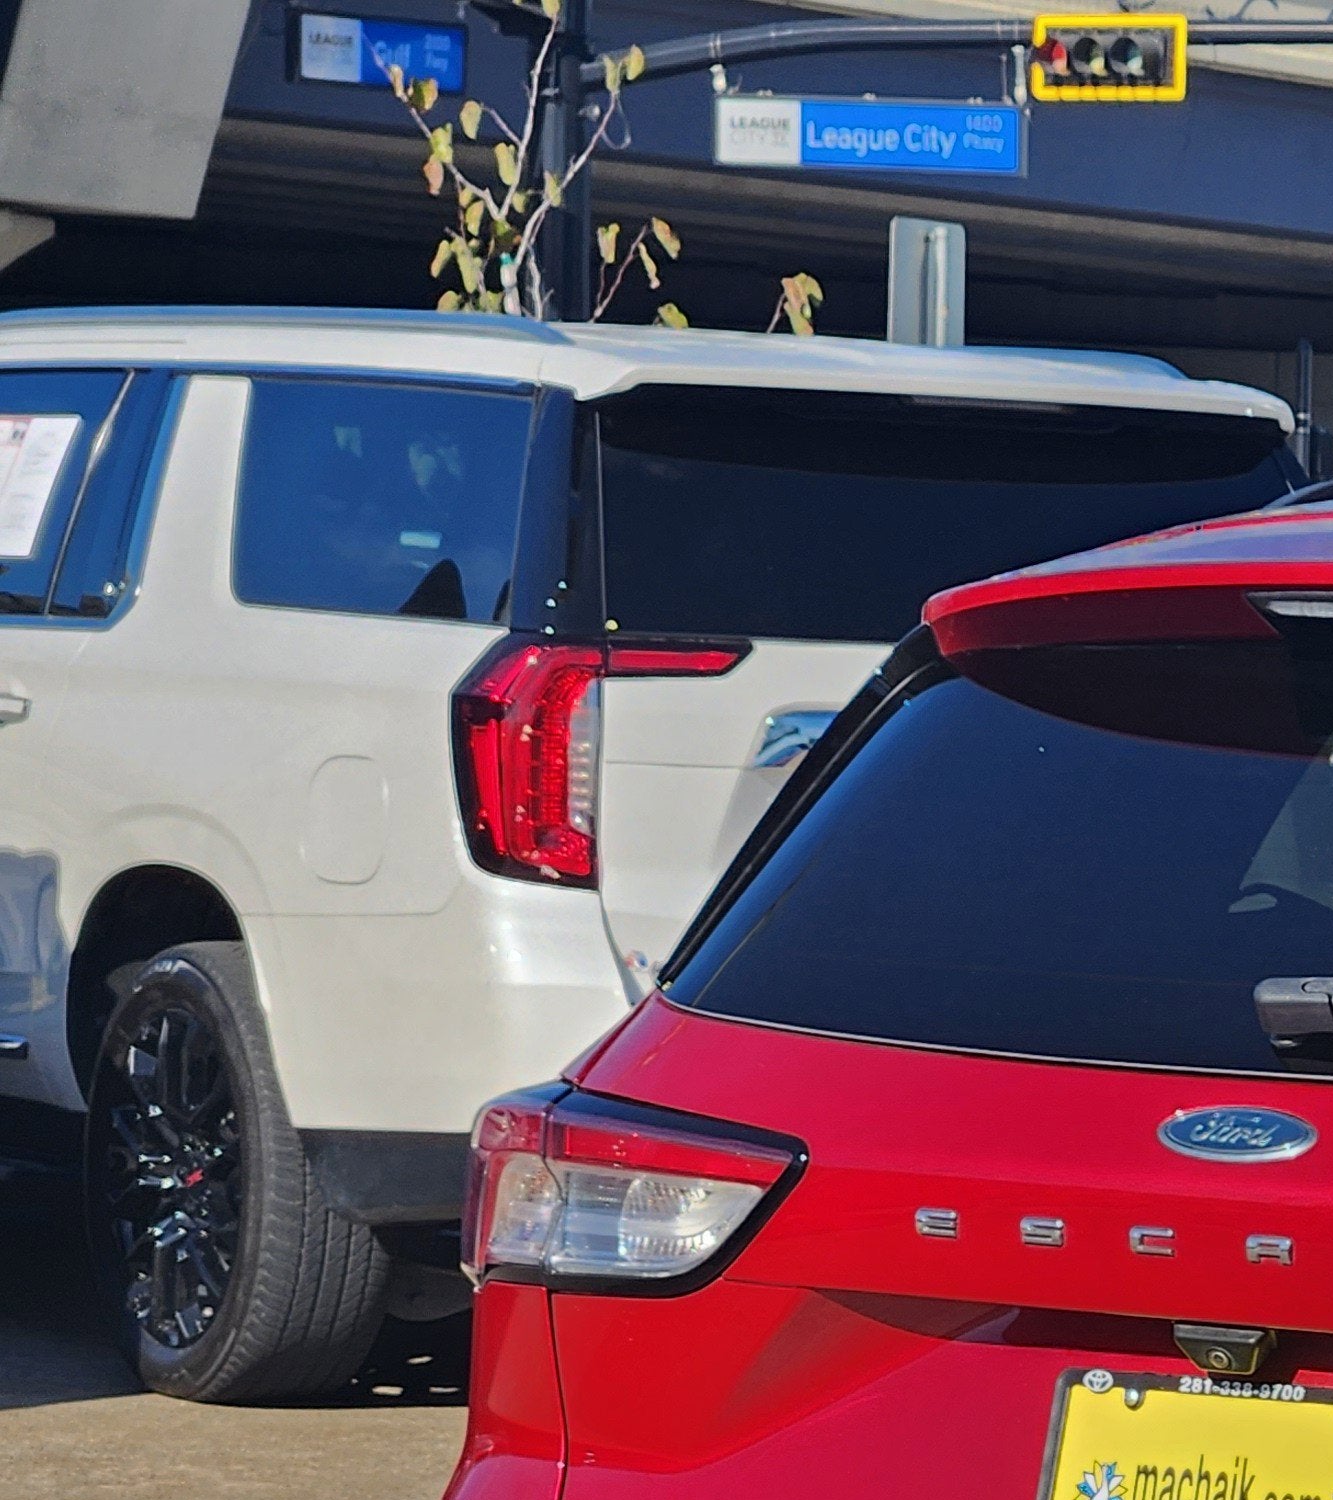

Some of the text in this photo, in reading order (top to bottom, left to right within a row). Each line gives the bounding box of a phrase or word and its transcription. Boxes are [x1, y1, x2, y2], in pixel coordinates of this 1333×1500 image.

[729, 116, 791, 131] LEAGUE
[806, 120, 899, 158] League
[903, 123, 957, 160] City
[1189, 1112, 1281, 1147] Ford
